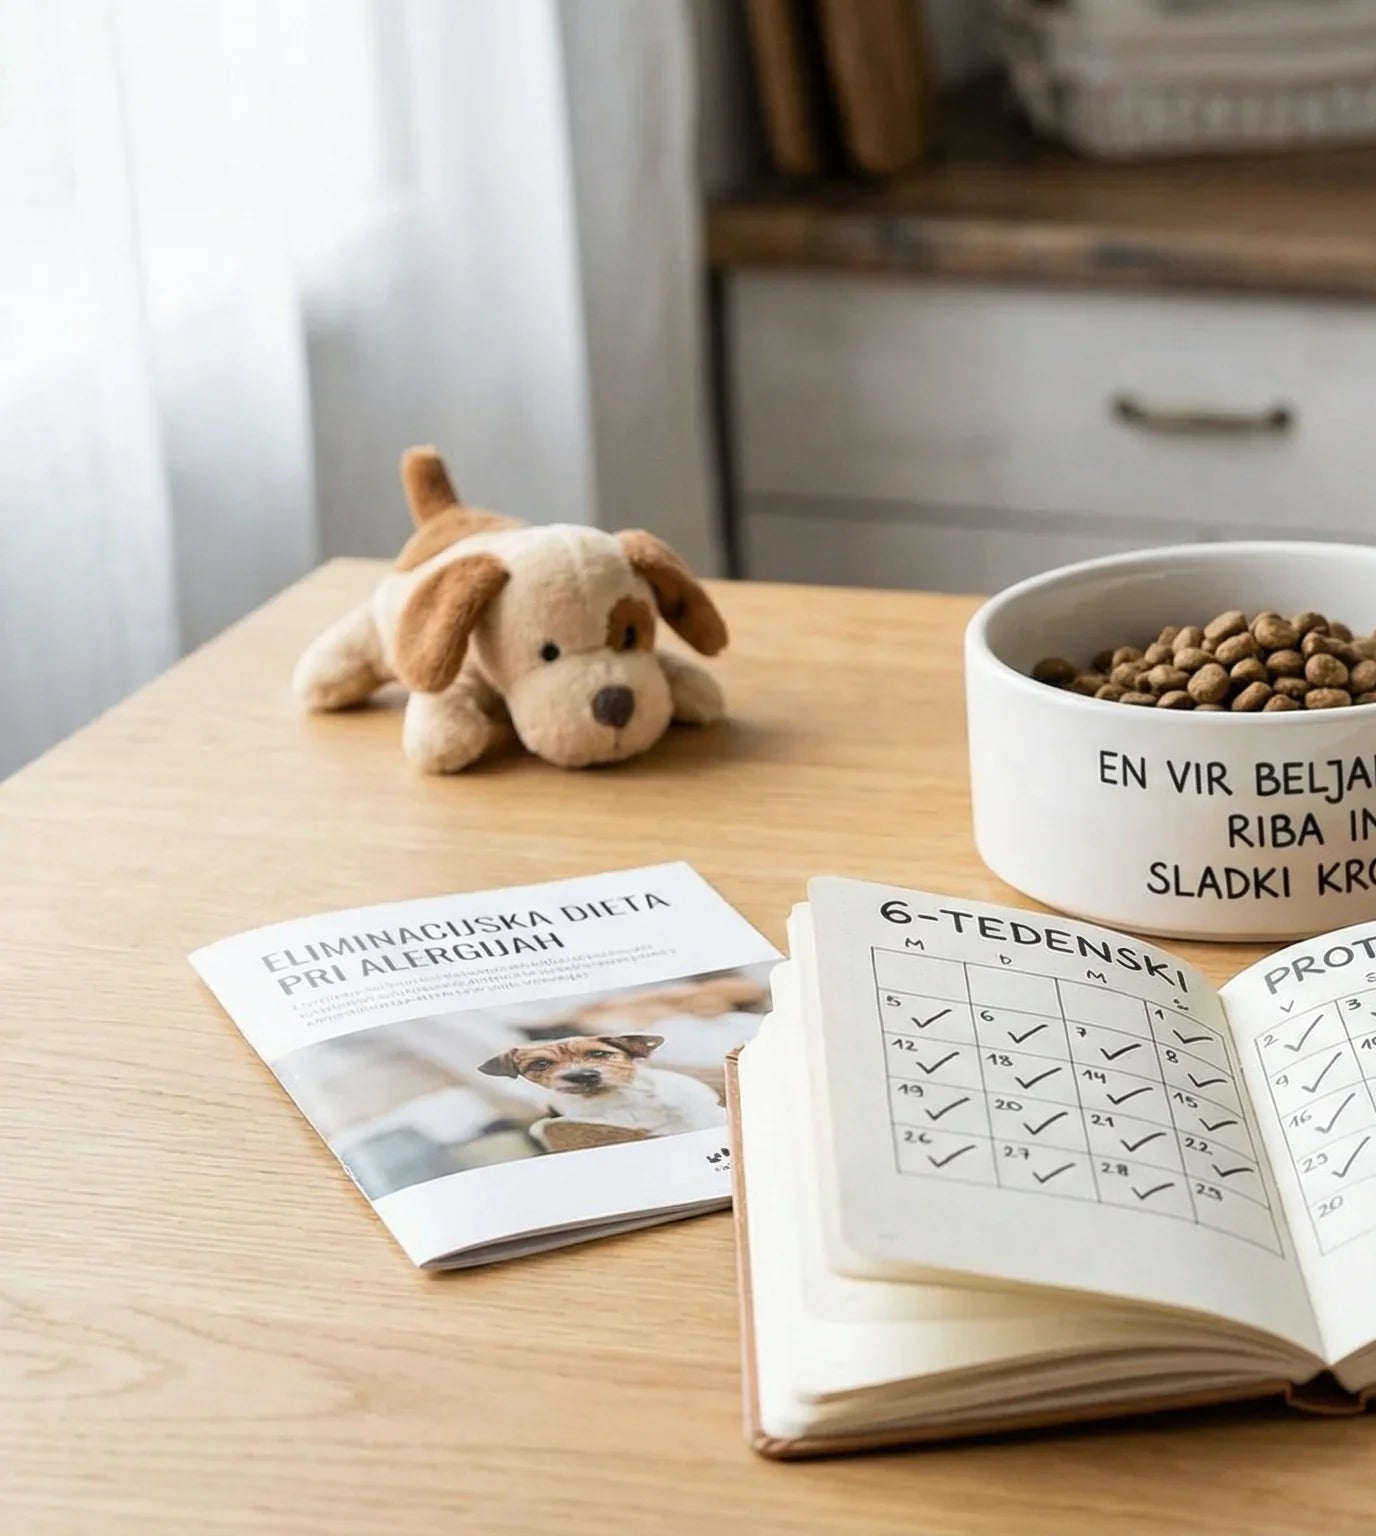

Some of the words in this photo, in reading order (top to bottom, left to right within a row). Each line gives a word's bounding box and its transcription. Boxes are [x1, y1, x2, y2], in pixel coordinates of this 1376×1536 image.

[1099, 750, 1147, 790] EN
[1166, 760, 1233, 797] VIR
[1227, 813, 1325, 849] RIBA
[1146, 861, 1291, 900] SLADKI
[261, 908, 554, 974] ELIMINACIJSKA
[563, 891, 672, 922] DIETA
[880, 900, 1189, 993] 6-TEDENSKI
[276, 964, 346, 997] PRI
[360, 931, 566, 978] ALERGIJAH
[905, 937, 925, 951] M
[1086, 970, 1108, 984] M
[980, 1010, 995, 1022] 6
[1166, 1050, 1179, 1064] 8
[1263, 1034, 1279, 1048] 2
[1345, 998, 1362, 1011] 3
[891, 1038, 918, 1052] 12
[1082, 1069, 1107, 1085] 14
[1173, 1092, 1198, 1109] 15
[897, 1083, 924, 1098] 19
[995, 1099, 1023, 1112] 20
[1091, 1114, 1115, 1128] 21
[1185, 1137, 1214, 1156] 22
[1288, 1109, 1313, 1129] 16
[1004, 1145, 1030, 1160] 27
